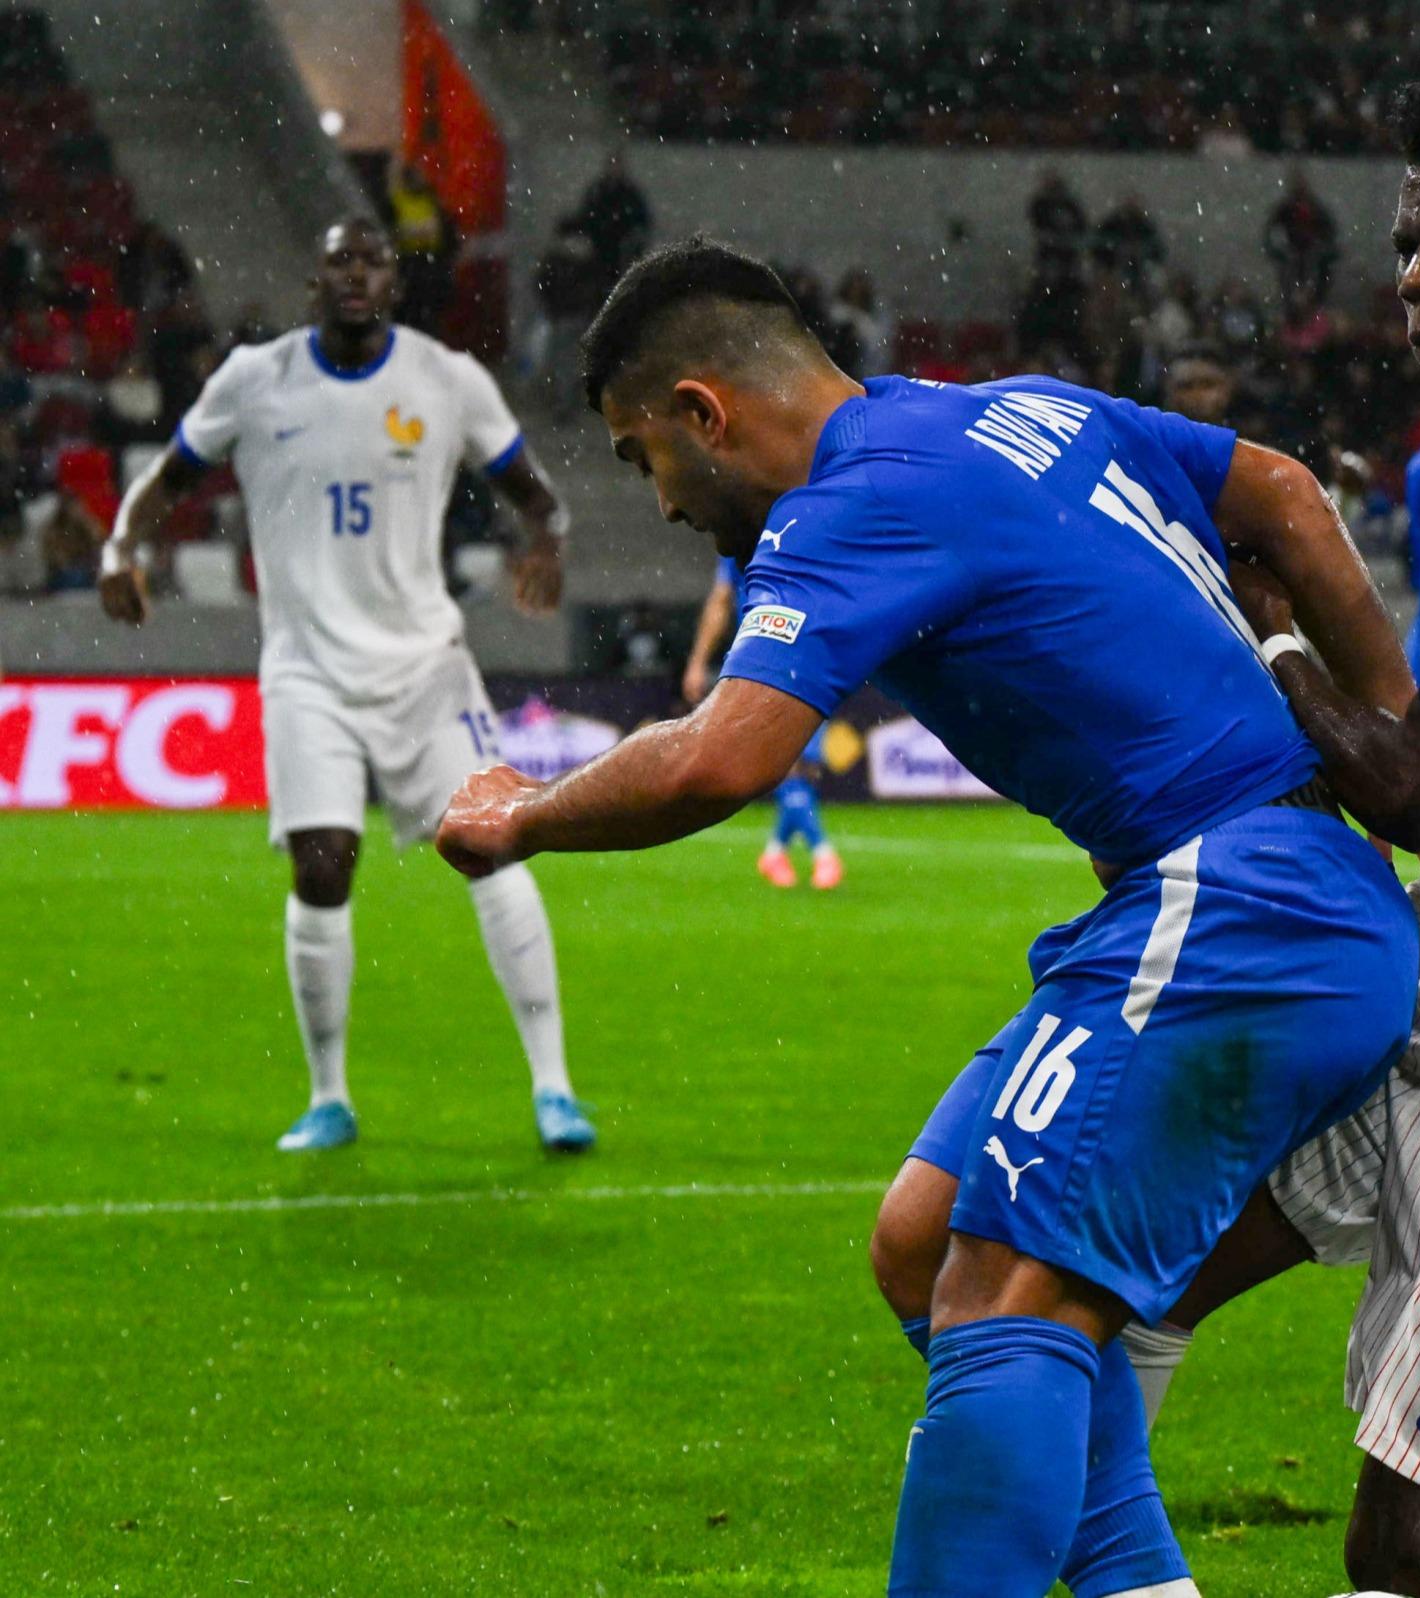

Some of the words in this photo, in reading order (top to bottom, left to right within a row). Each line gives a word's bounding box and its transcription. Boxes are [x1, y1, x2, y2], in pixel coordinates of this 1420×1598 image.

[1000, 391, 1093, 446] ANI
[326, 481, 374, 537] 15
[0, 683, 235, 811] FC
[991, 1012, 1094, 1133] 16
